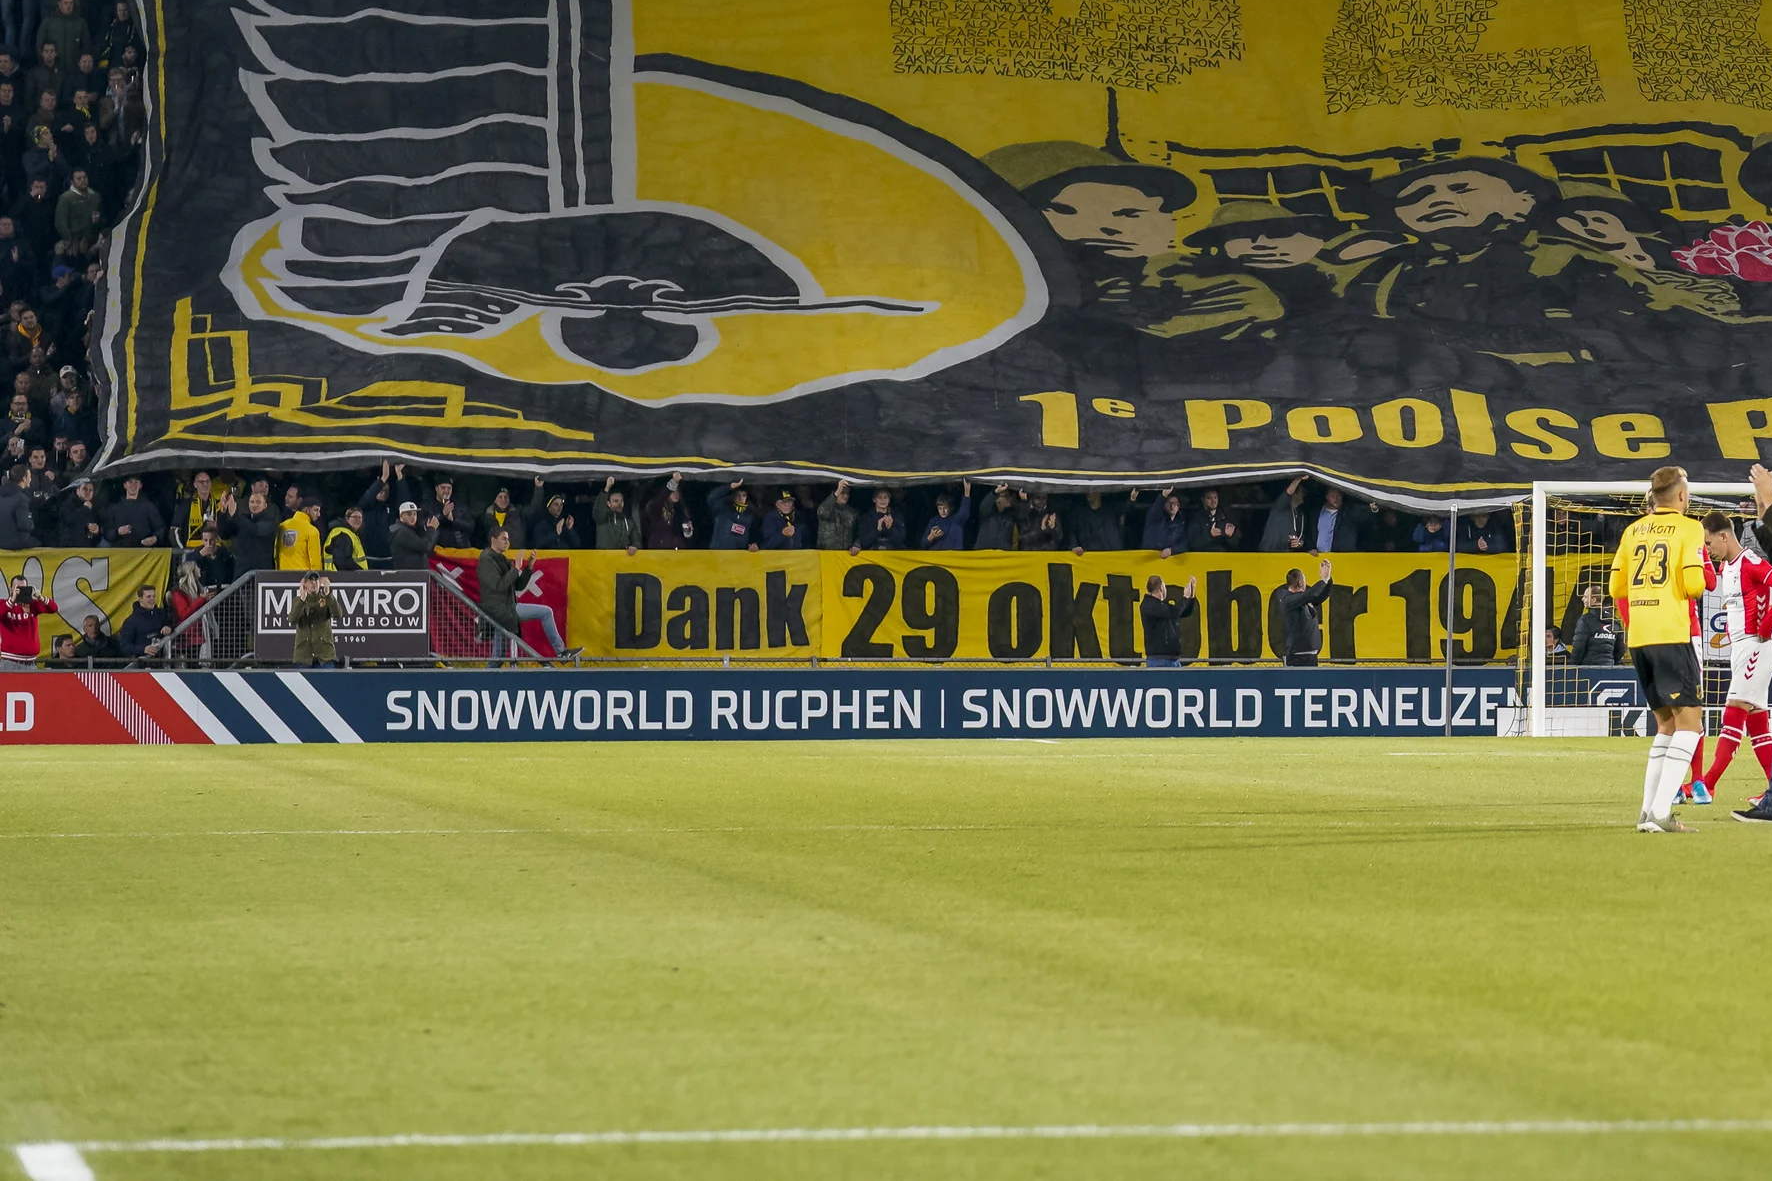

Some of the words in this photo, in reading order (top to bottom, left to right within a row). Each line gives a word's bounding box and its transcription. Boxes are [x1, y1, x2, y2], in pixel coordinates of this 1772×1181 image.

[1185, 388, 1671, 462] Poolse
[1632, 541, 1671, 589] 23
[614, 570, 809, 650] Dank
[841, 564, 960, 663] 29
[387, 689, 693, 731] SNOWWORLD
[712, 688, 921, 730] RUCPHEN
[962, 688, 1262, 729] SNOWWORLD
